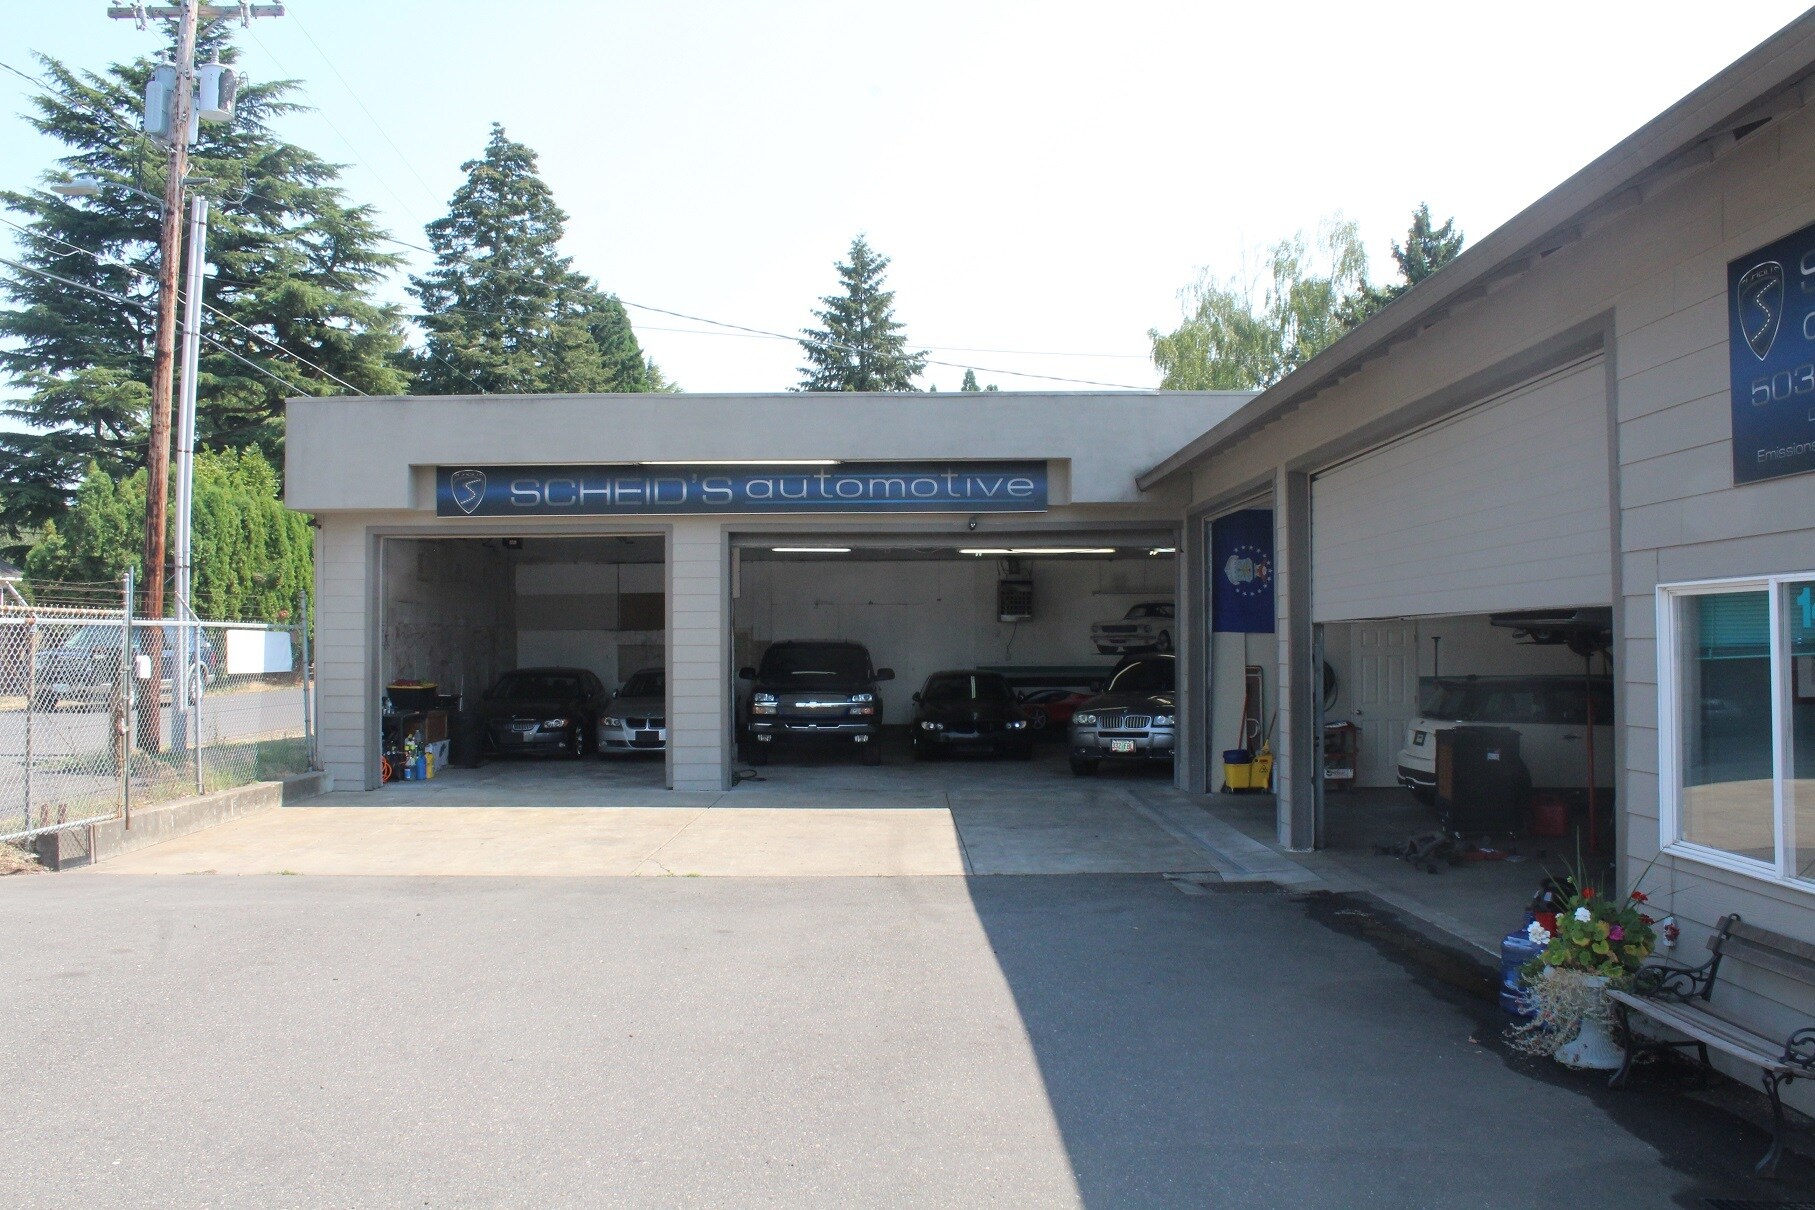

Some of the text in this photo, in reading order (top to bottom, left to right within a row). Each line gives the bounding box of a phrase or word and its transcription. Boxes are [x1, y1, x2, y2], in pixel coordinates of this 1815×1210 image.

[1752, 364, 1815, 406] 503
[510, 467, 1034, 507] SCHEID'S automotive
